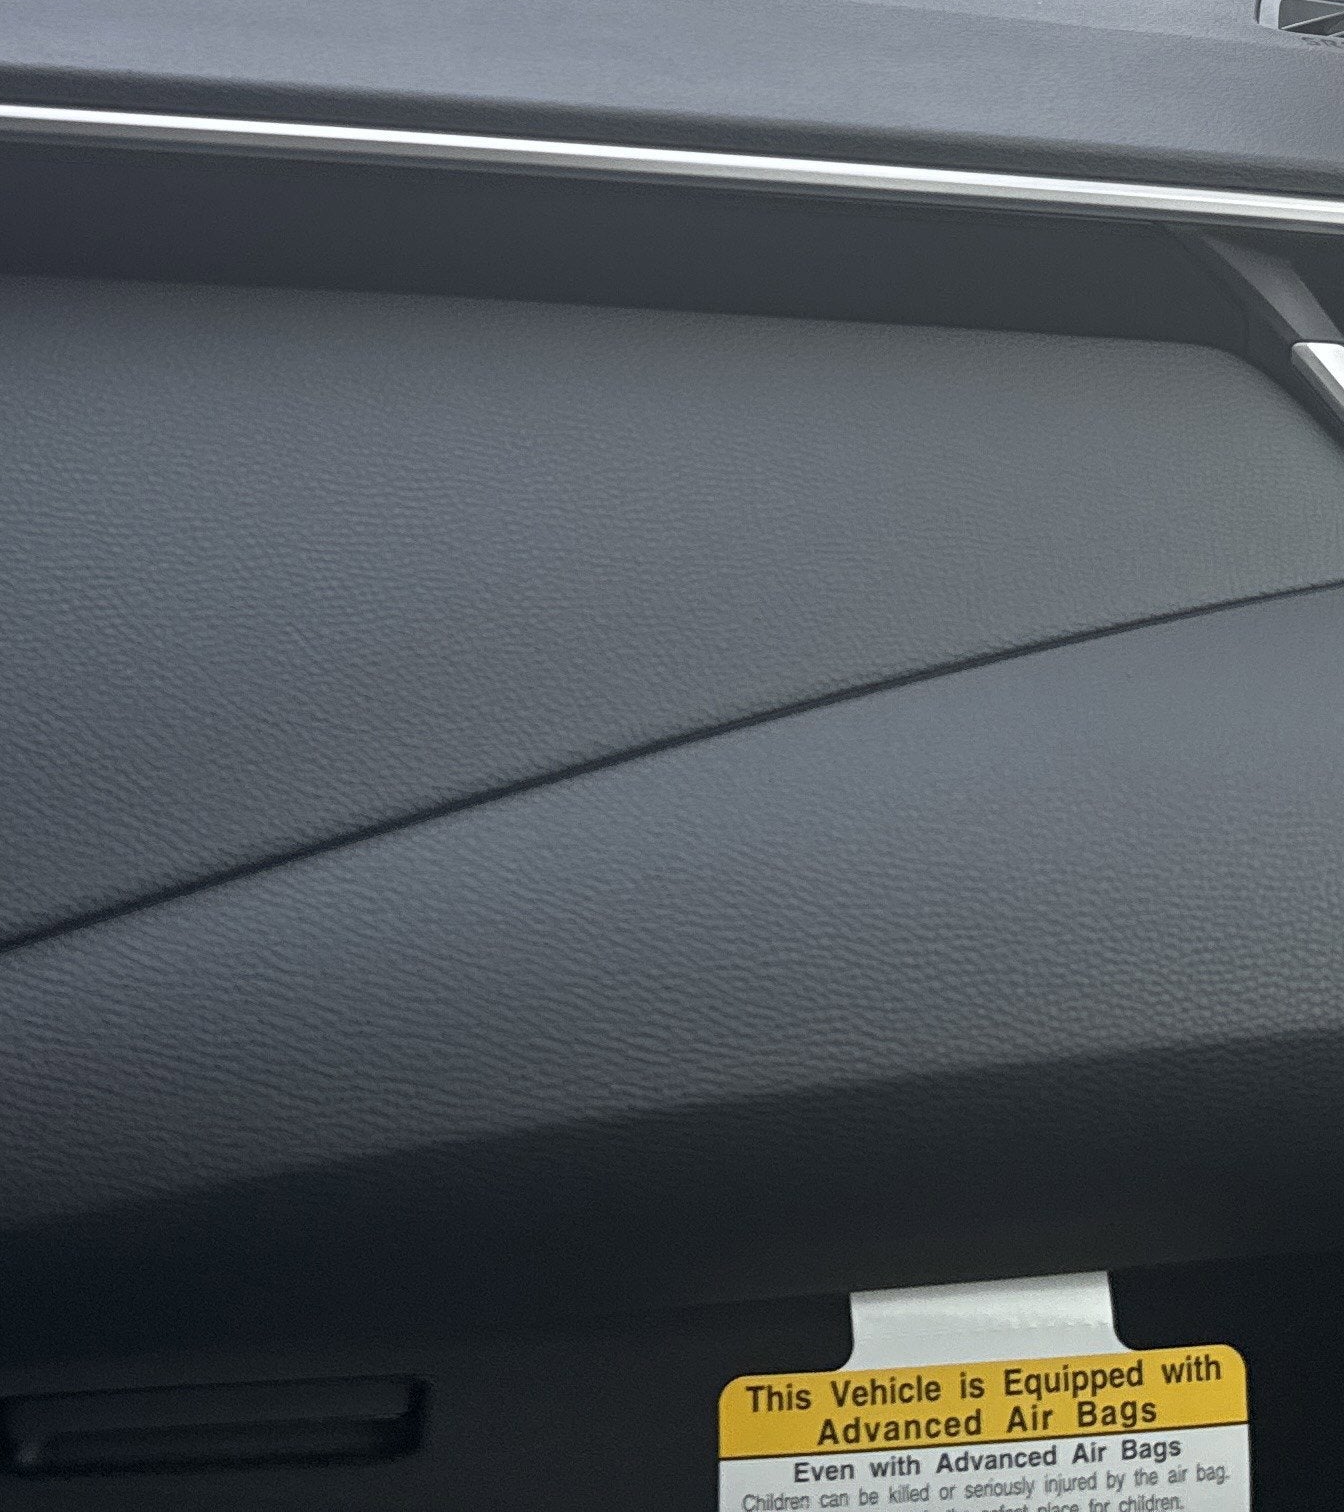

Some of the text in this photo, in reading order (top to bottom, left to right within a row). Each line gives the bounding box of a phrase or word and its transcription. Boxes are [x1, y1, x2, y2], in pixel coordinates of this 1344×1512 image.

[745, 1354, 1222, 1413] This Vehicle is Equipped with
[817, 1399, 1157, 1446] Advanced Air Bags
[793, 1439, 1182, 1483] Even with Advanced Air Bags
[742, 1462, 1231, 1512] Children can be killed or seriously injured by the air bag.
[1089, 1498, 1111, 1512] for
[1118, 1493, 1185, 1512] children.
